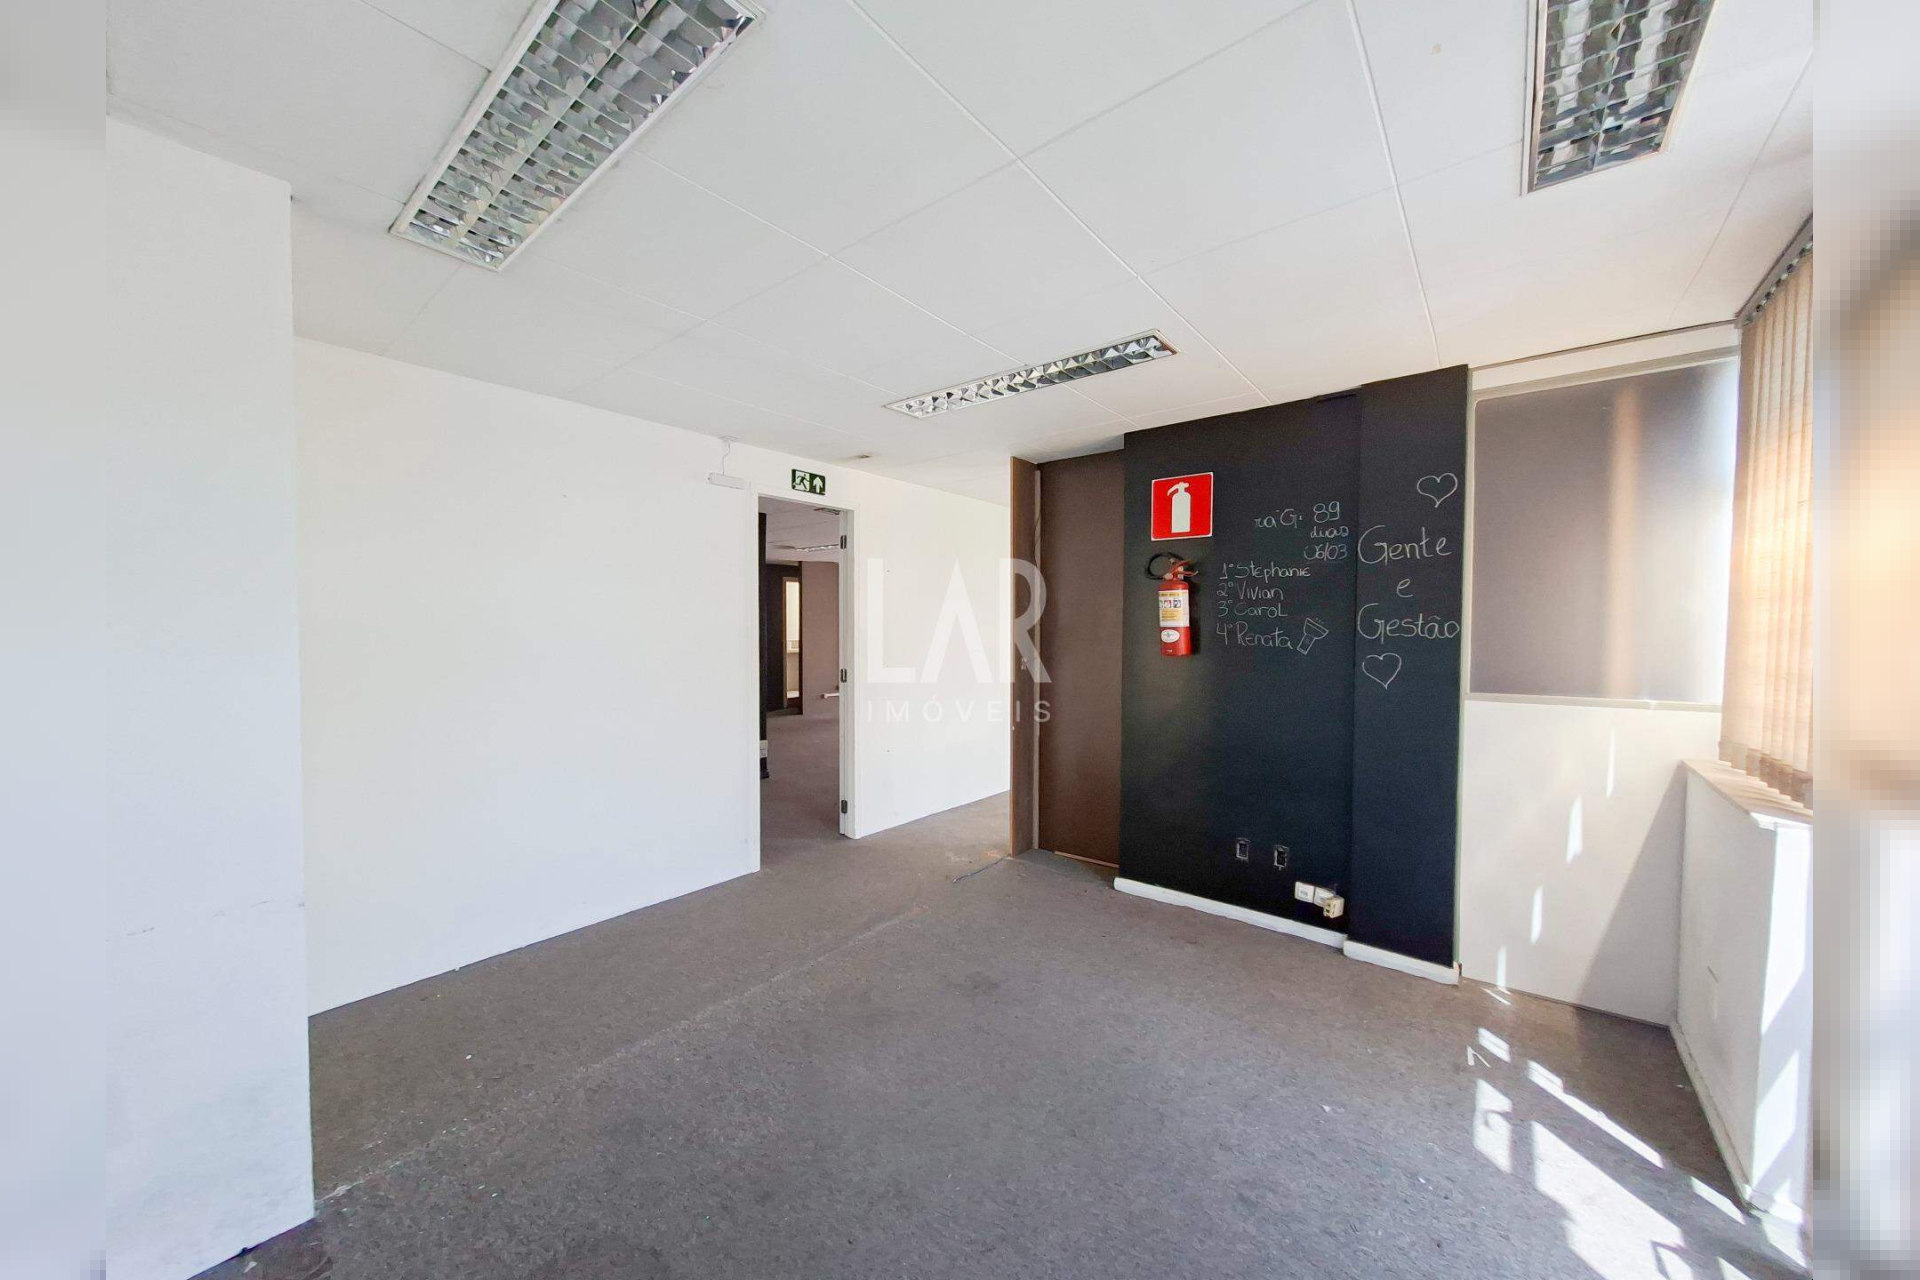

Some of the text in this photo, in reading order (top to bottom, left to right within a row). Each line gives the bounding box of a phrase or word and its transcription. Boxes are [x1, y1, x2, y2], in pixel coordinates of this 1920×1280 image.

[1313, 501, 1340, 523] 89
[1303, 543, 1348, 560] 06/03
[1358, 524, 1453, 566] Gente
[1237, 580, 1283, 600] Vivian
[1396, 578, 1414, 598] e
[1357, 602, 1460, 644] Gestão
[1236, 621, 1293, 650] Renata
